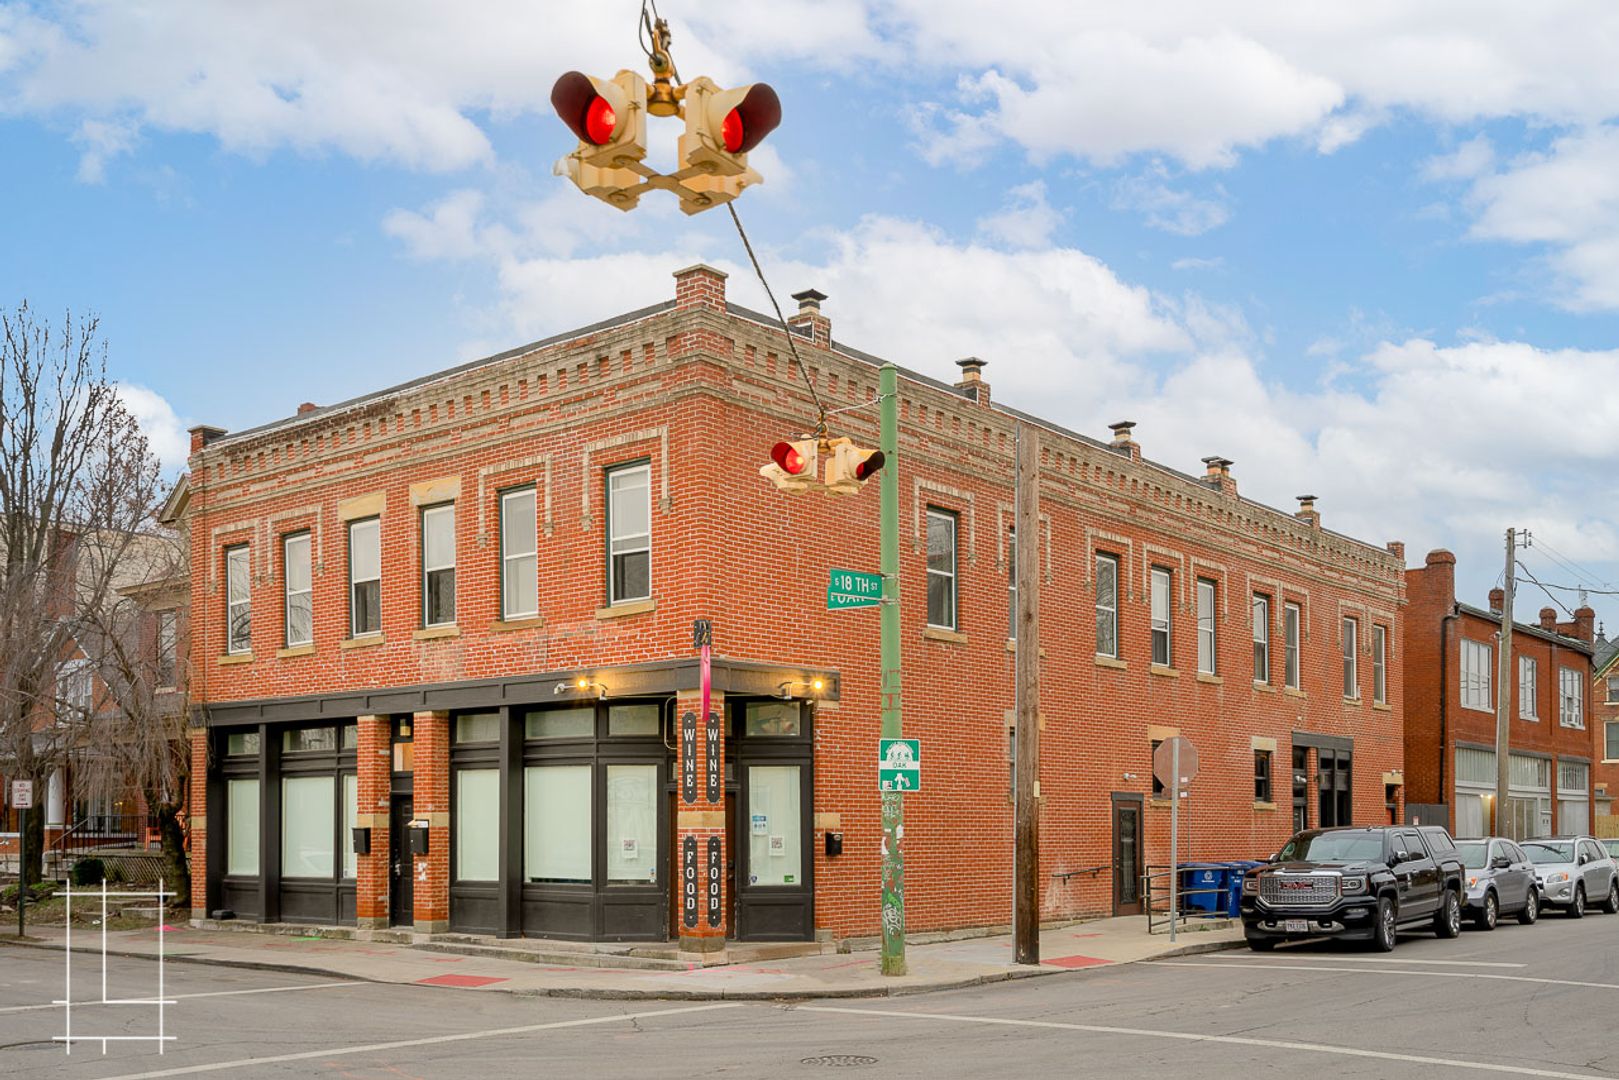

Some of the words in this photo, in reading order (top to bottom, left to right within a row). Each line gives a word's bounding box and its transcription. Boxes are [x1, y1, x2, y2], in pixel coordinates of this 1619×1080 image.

[835, 577, 840, 586] S
[841, 575, 853, 591] 18
[684, 728, 695, 787] WINE
[707, 728, 719, 787] WINE
[686, 851, 695, 910] FOOD
[710, 851, 719, 910] FOOD
